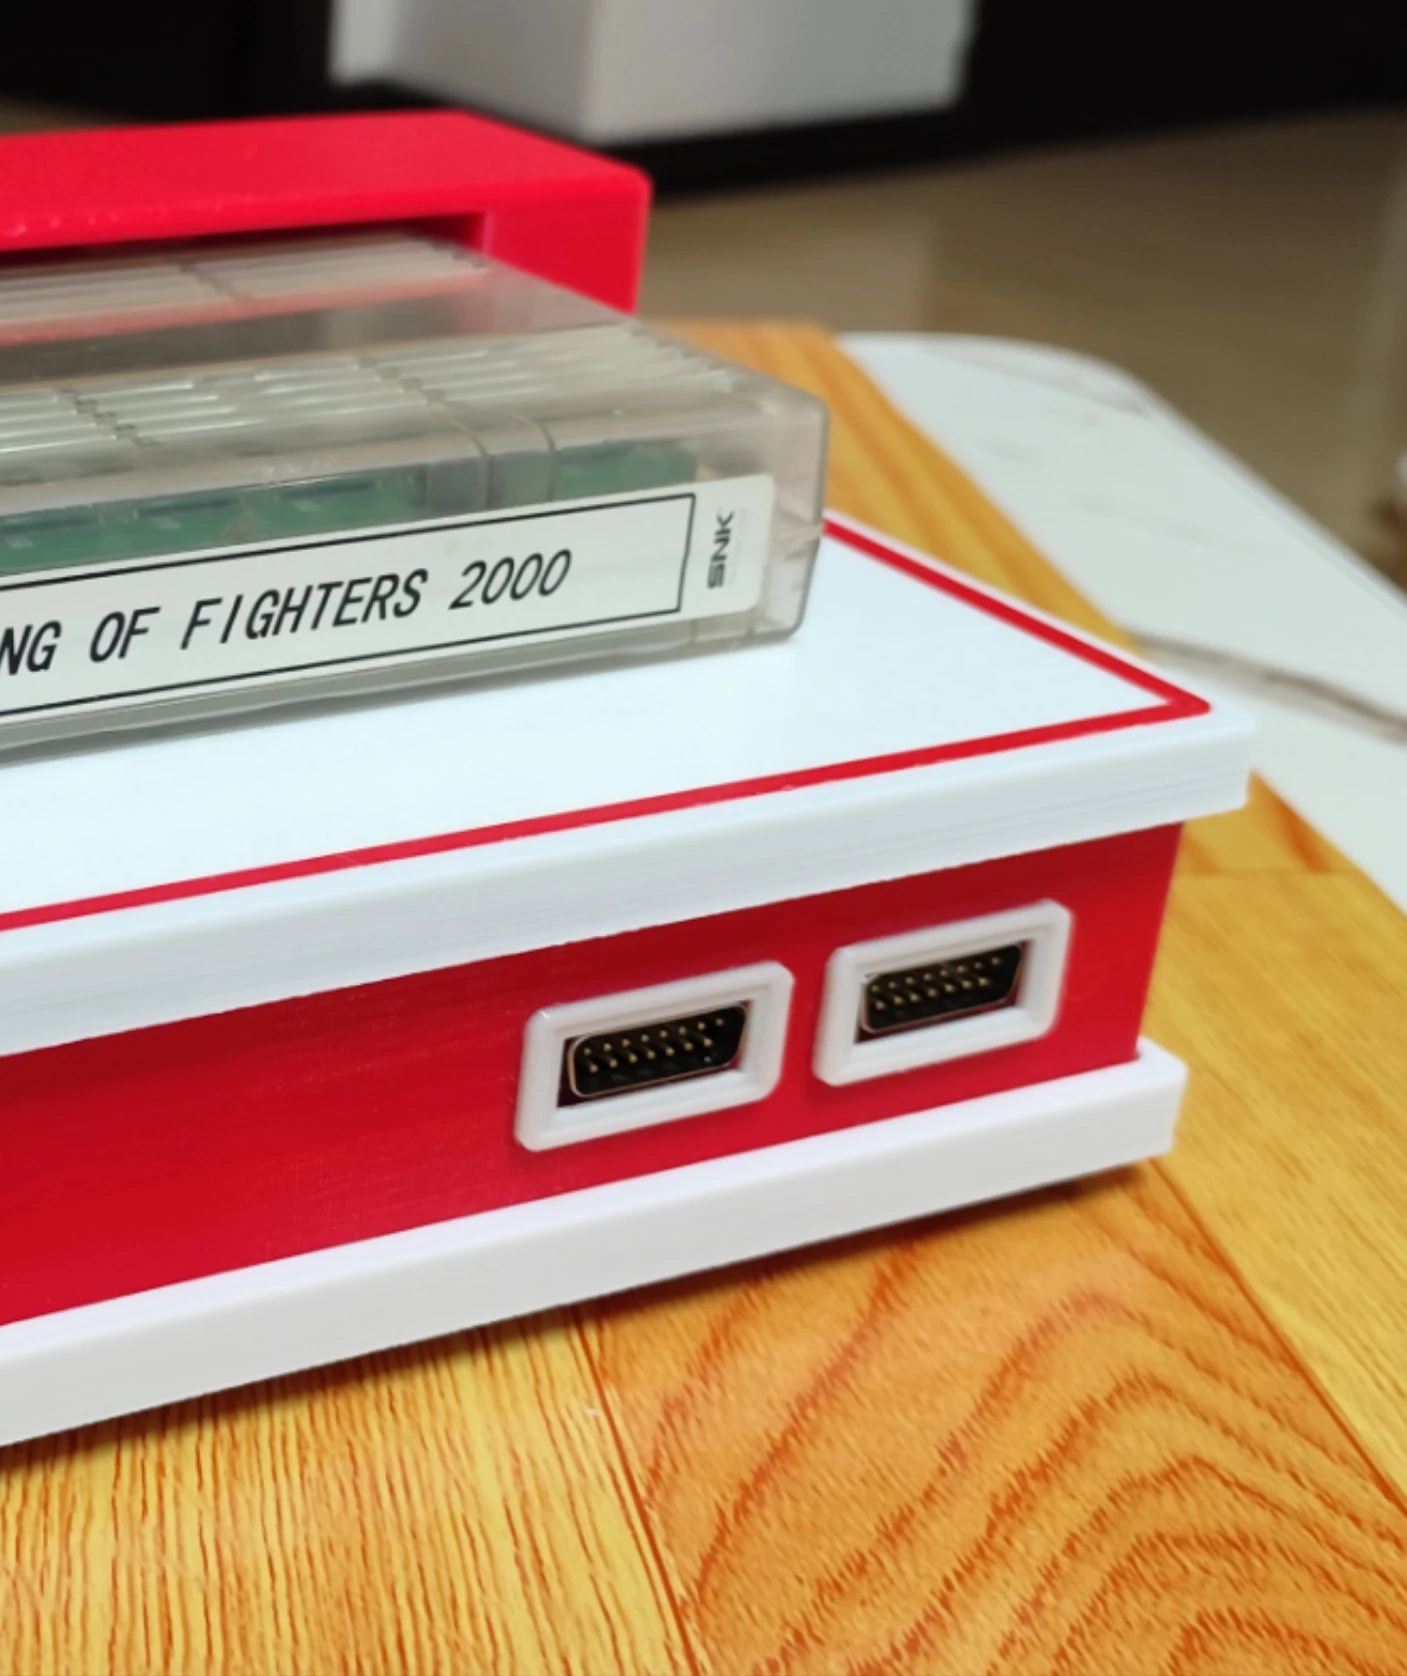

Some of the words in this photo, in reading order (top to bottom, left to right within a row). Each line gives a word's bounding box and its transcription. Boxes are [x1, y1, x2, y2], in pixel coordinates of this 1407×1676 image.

[706, 508, 734, 589] SNK
[90, 606, 161, 663] OF
[181, 568, 429, 650] FIGHTERS
[449, 549, 573, 611] 2000
